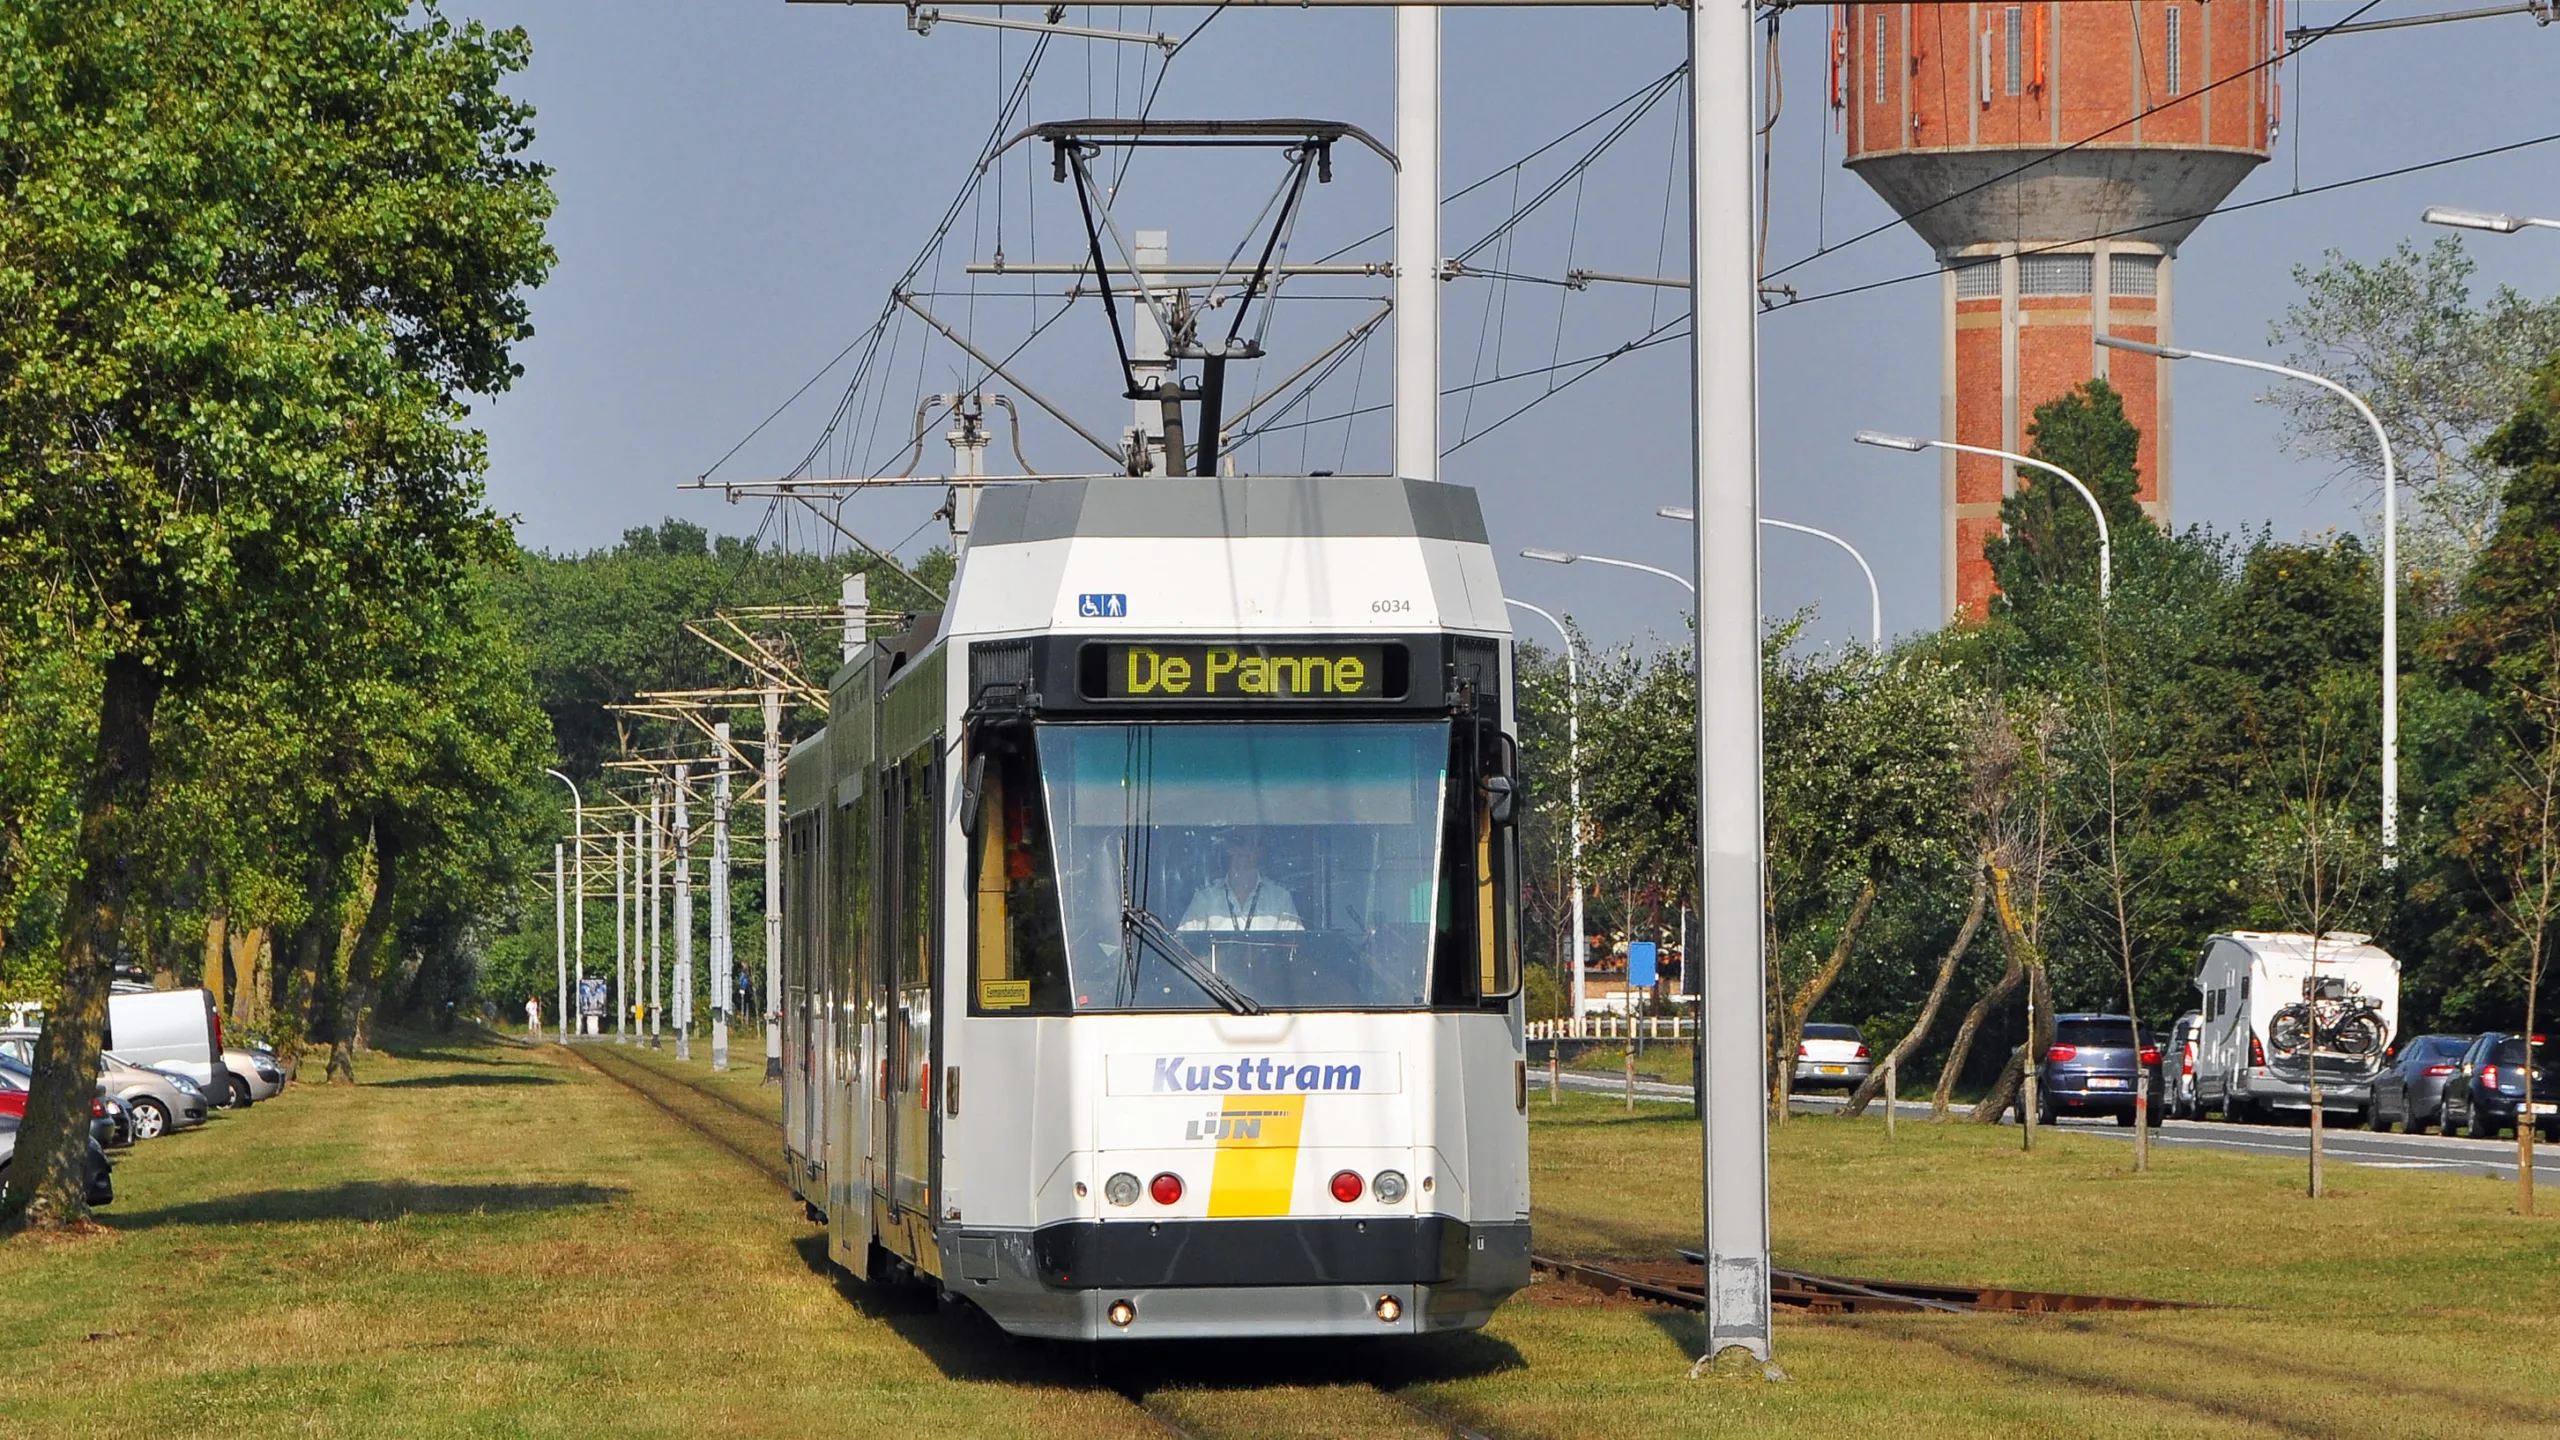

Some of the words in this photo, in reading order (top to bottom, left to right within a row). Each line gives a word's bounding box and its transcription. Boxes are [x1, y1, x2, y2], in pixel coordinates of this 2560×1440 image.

[1372, 600, 1411, 613] 6034
[1128, 647, 1191, 694] De
[1206, 646, 1366, 694] Panne
[1152, 1057, 1362, 1092] Kusttram
[1185, 1119, 1262, 1140] LIJN
